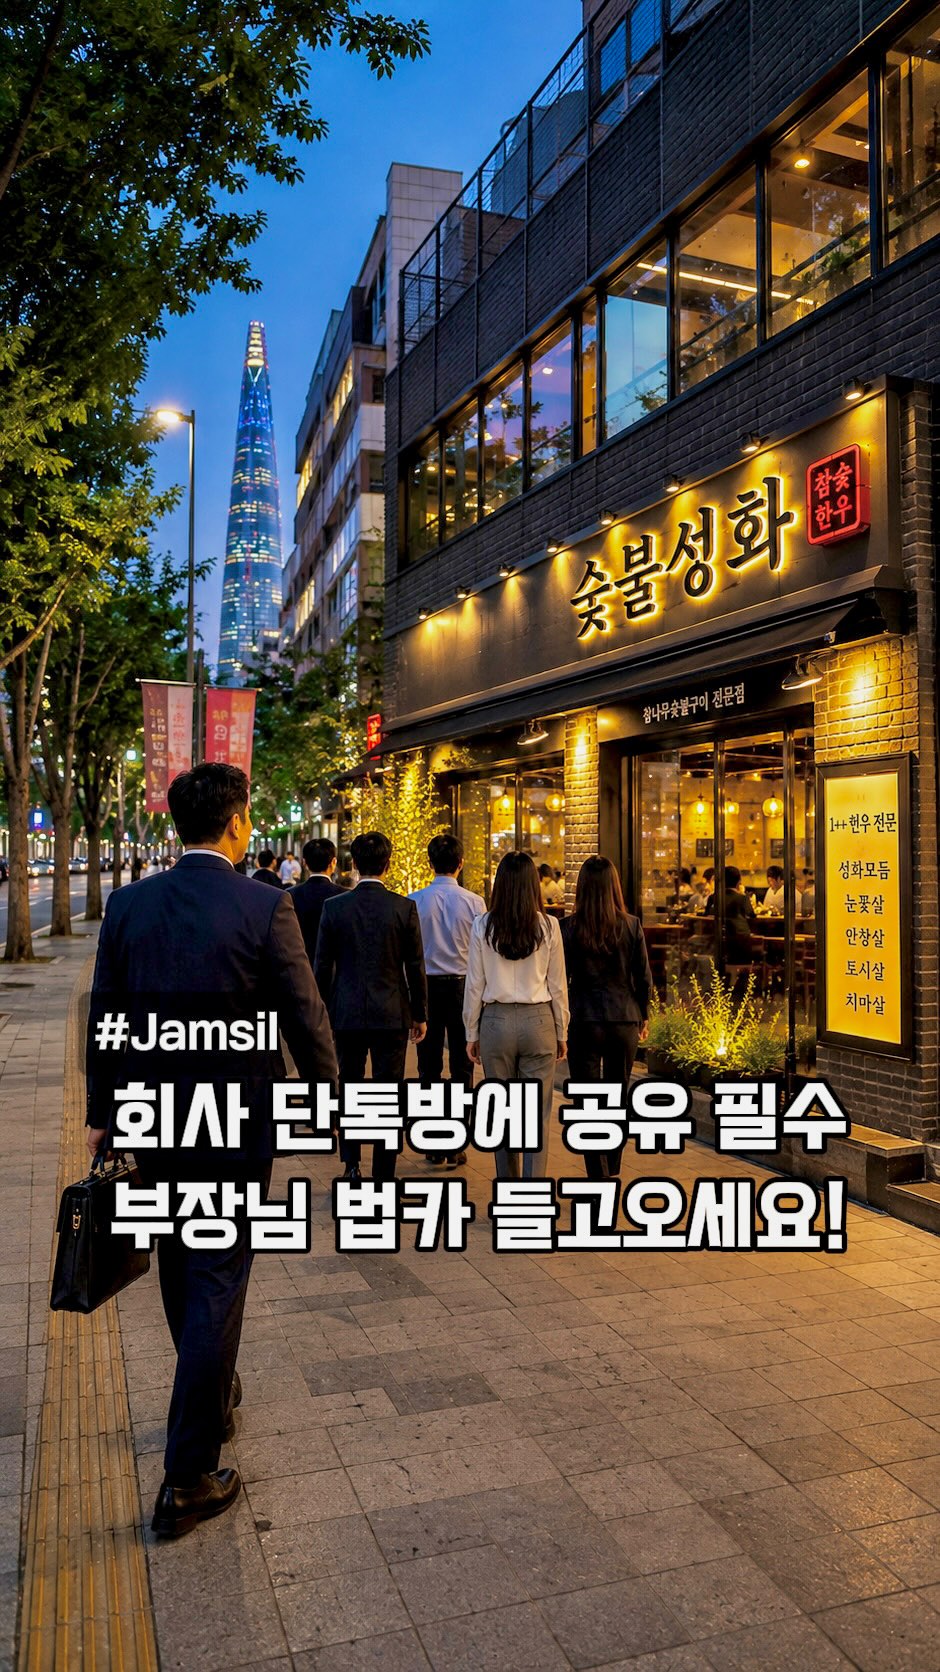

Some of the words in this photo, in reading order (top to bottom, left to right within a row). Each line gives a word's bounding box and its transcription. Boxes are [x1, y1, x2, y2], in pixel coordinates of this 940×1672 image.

[814, 494, 853, 531] 한우
[569, 475, 796, 639] 숯불성화
[873, 812, 897, 833] 전문
[838, 860, 891, 880] 성화모듬
[844, 894, 885, 915] 눈꽃살
[845, 927, 885, 949] 안창살
[845, 960, 885, 982] 토시살
[845, 992, 886, 1016] 치마살
